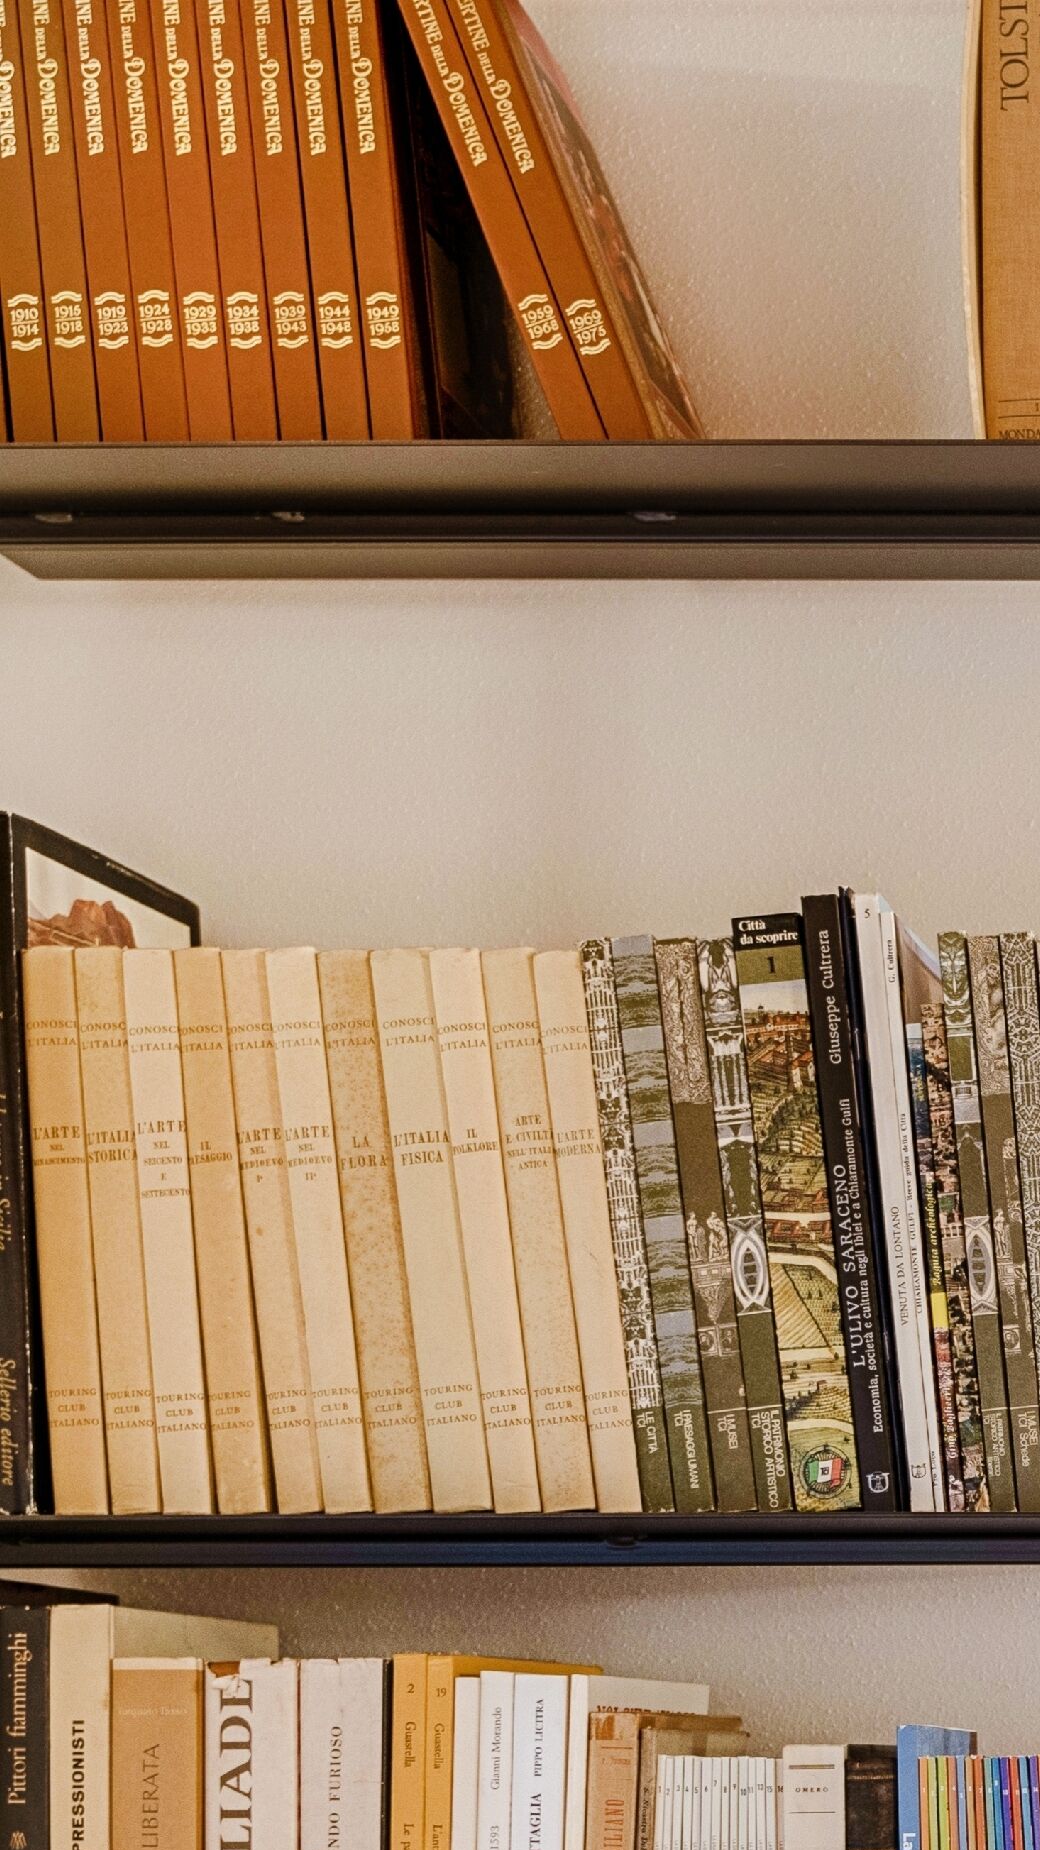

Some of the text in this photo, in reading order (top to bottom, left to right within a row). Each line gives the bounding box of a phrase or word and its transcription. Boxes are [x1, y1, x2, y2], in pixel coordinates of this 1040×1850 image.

[37, 58, 60, 156] DOMENICA
[213, 58, 237, 156] DOMENICA
[352, 57, 376, 155] DOMENICA
[431, 45, 449, 77] DELLA
[443, 72, 488, 167] DOMENICA
[477, 52, 535, 174] DELLA DOMENICA
[10, 308, 39, 323] 1910
[97, 305, 126, 320] 1919
[139, 303, 170, 318] 1924
[184, 305, 217, 320] 1929
[227, 305, 259, 319] 1934
[274, 304, 306, 319] 1939
[319, 304, 350, 319] 1944
[366, 304, 399, 320] 1949
[522, 305, 554, 324] 1959
[55, 320, 83, 335] 1918
[142, 319, 173, 333] 1928
[230, 320, 260, 335] 1938
[320, 320, 351, 335] 1948
[569, 309, 602, 330] 1969
[12, 323, 40, 337] 1914
[99, 321, 128, 336] 1923
[187, 321, 217, 336] 1933
[277, 321, 307, 335] 1943
[528, 319, 559, 339] 1968
[577, 326, 606, 345] 1975
[1034, 402, 1040, 412] 1
[864, 908, 871, 918] 5
[738, 919, 766, 931] Città
[740, 929, 798, 945] da scoprire
[767, 955, 776, 974] 1
[818, 930, 842, 1065] Giuseppe Cultrera
[382, 1016, 435, 1030] CONOSCI
[839, 1099, 852, 1127] Gulfi
[34, 1125, 81, 1140] L'ARTE
[394, 1129, 450, 1148] L'ITALIA
[466, 1128, 478, 1139] IL
[353, 1135, 371, 1149] LA
[341, 1156, 388, 1171] FLORA
[401, 1151, 444, 1167] FISICA
[845, 1130, 860, 1200] Chiaramonte
[852, 1202, 861, 1210] a
[850, 1222, 864, 1247] Iblei
[833, 1164, 866, 1368] L'ULIVO SARACENO
[854, 1249, 869, 1277] negli
[890, 1206, 908, 1326] VENUTA DA LONTANO
[859, 1279, 873, 1320] cultura
[864, 1320, 872, 1329] e
[863, 1332, 877, 1371] società
[424, 1384, 473, 1396] TOURING
[534, 1385, 582, 1397] TOURING
[435, 1401, 463, 1410] CLUB
[545, 1401, 573, 1411] CLUB
[868, 1374, 884, 1433] Economia,
[0, 1358, 19, 1486] Sellerio editore
[427, 1414, 478, 1427] ITALIANO
[536, 1415, 585, 1427] ITALIANO
[683, 1412, 699, 1490] PAESAGGI UMANI
[771, 1420, 785, 1477] PATRIMONIO
[760, 1411, 779, 1508] STORICO ARTISTICO
[406, 1683, 415, 1694] 2
[436, 1687, 447, 1697] 19
[7, 1631, 32, 1804] Pittori fiamminghi
[534, 1699, 544, 1742] LICITRA
[491, 1706, 503, 1753] Morando
[404, 1721, 417, 1769] Guastella
[433, 1723, 445, 1770] Guastella
[329, 1725, 343, 1802] FURIOSO
[533, 1745, 543, 1777] PIPPO
[490, 1758, 501, 1790] Gianni
[142, 1742, 161, 1849] LIBERATA
[403, 1823, 414, 1836] Le
[489, 1825, 500, 1850] 1593
[902, 1832, 915, 1850] La
